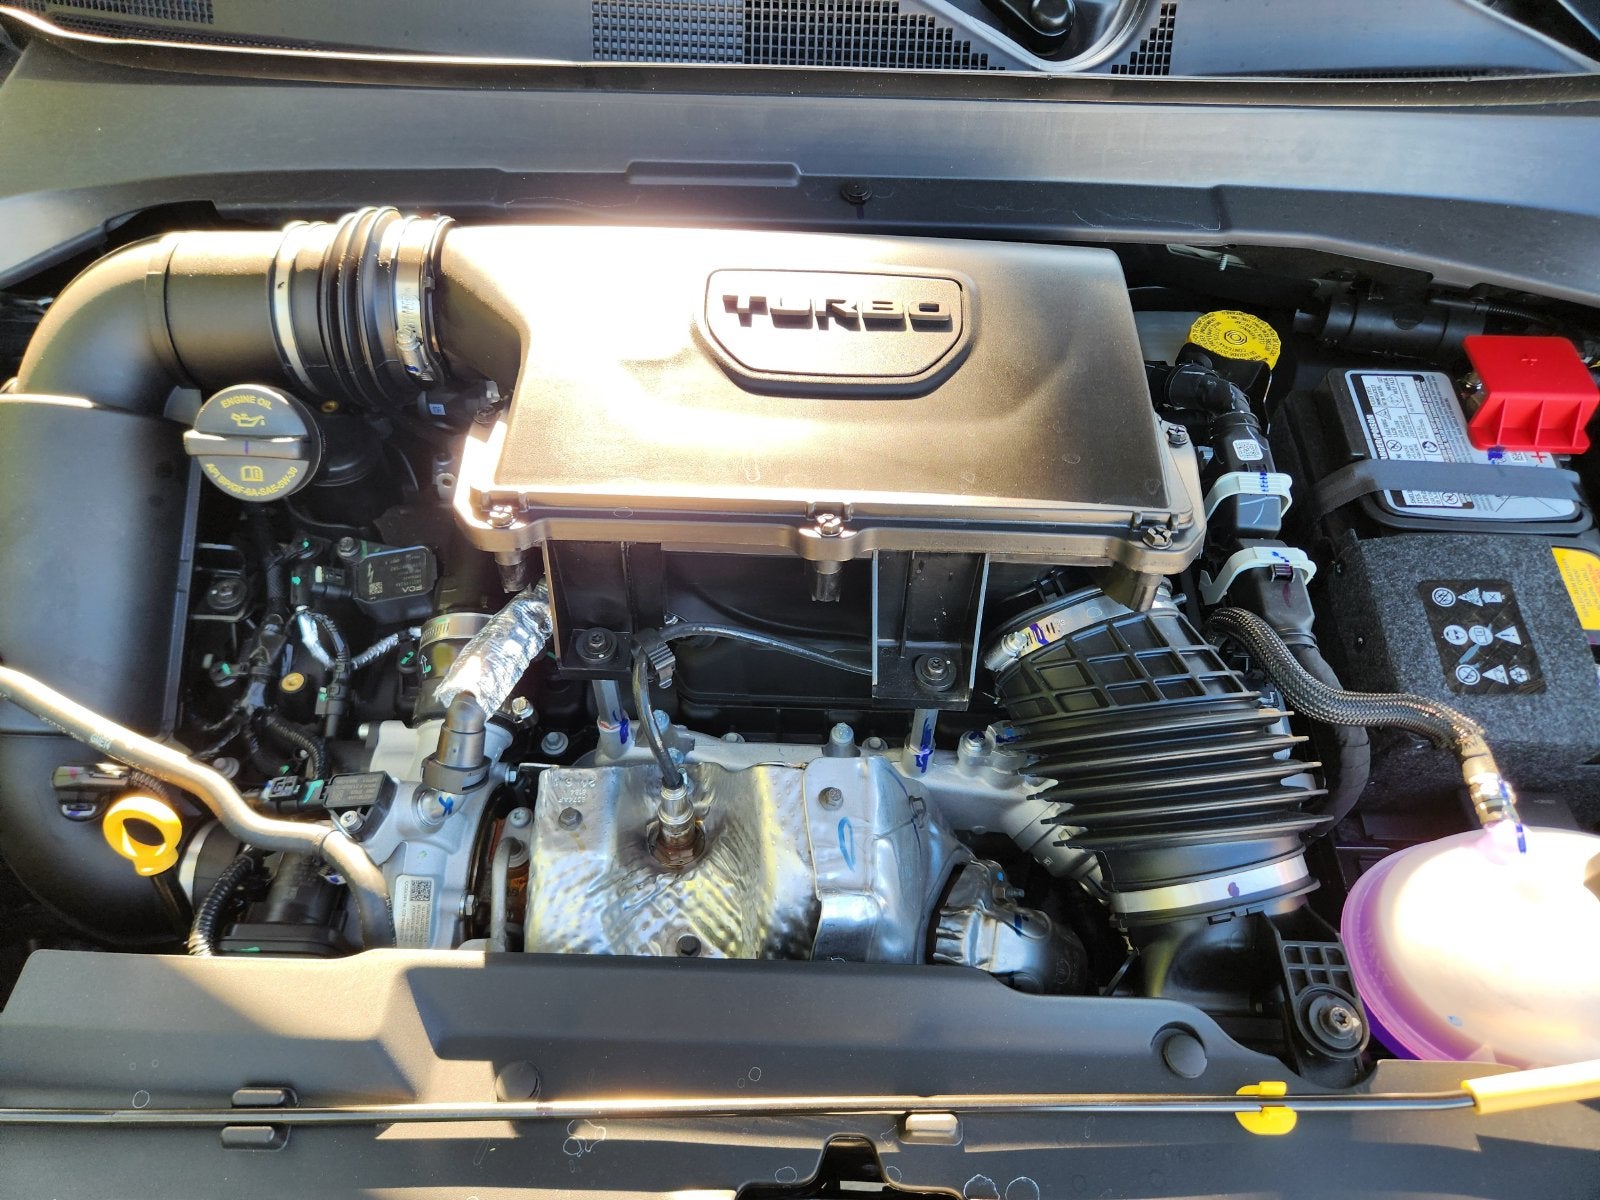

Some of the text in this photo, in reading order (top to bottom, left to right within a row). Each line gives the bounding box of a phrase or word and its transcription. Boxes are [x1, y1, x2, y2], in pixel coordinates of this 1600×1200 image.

[722, 289, 953, 332] TURBO
[220, 394, 272, 410] ENGINE OIL
[206, 463, 219, 478] API
